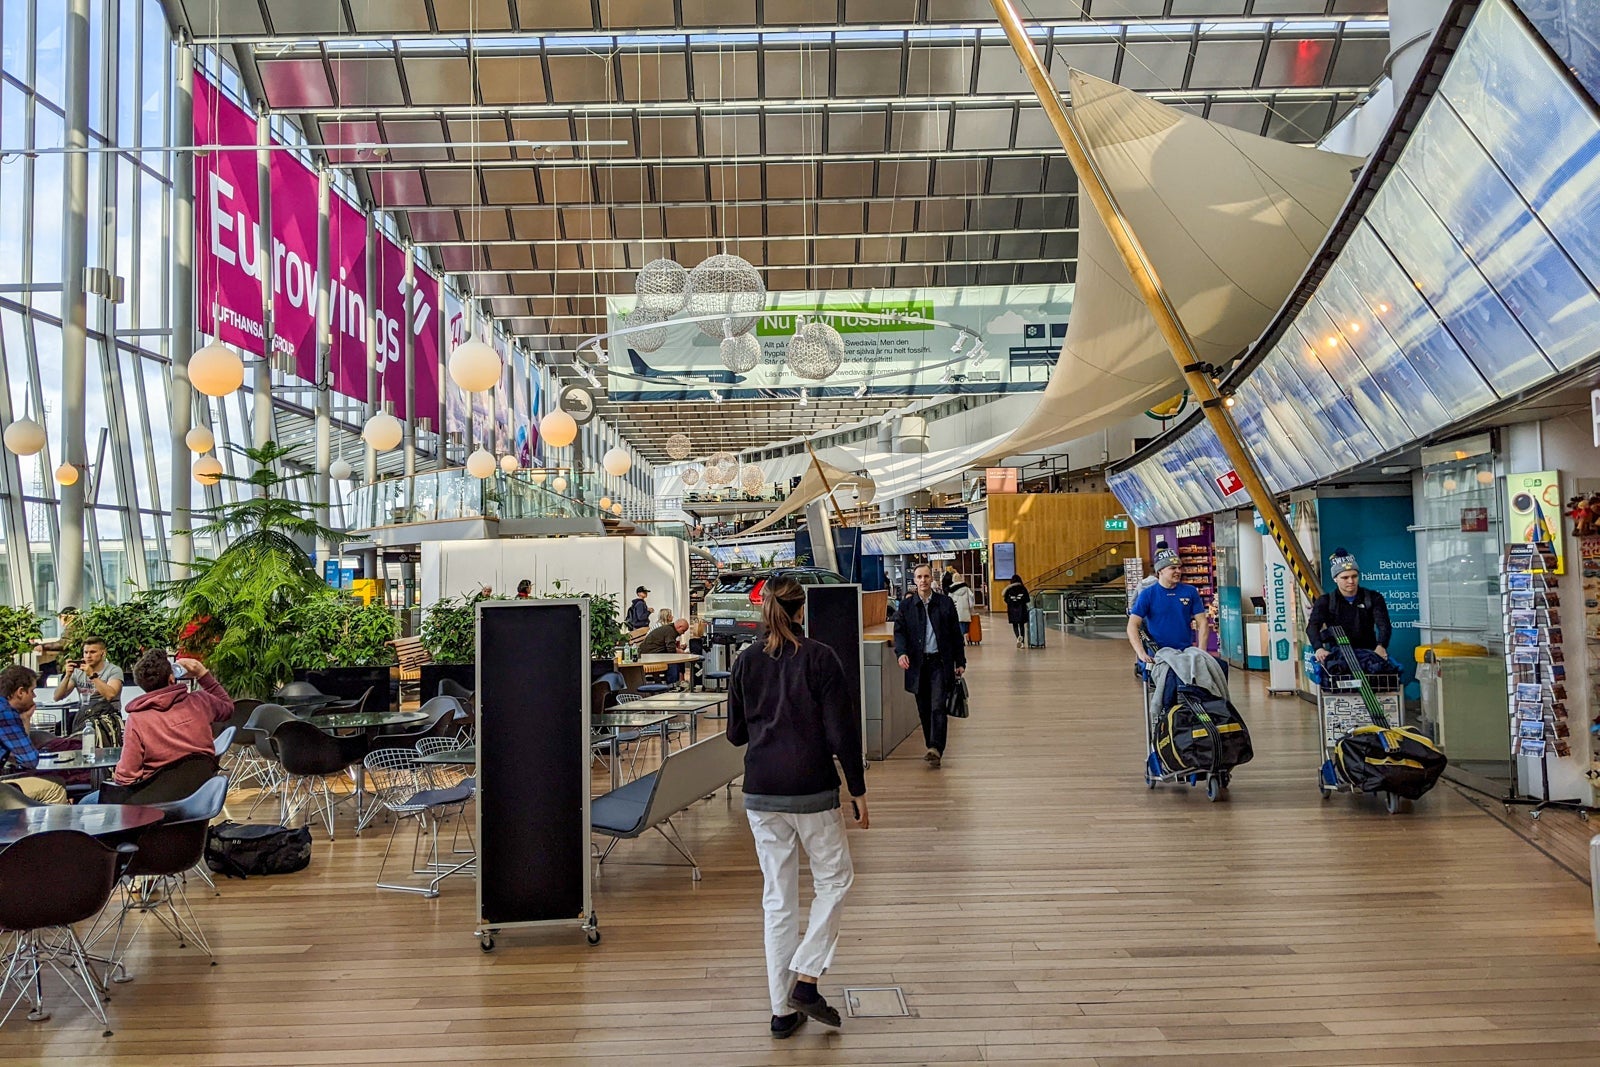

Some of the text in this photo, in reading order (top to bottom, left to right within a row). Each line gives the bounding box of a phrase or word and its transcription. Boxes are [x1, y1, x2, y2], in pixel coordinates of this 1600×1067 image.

[209, 170, 400, 373] Eurowings
[763, 312, 790, 330] Nu
[212, 302, 295, 356] LUFTHANSA GROUP
[764, 341, 775, 349] Allt
[775, 341, 785, 349] på
[764, 350, 786, 359] flygpla
[856, 347, 875, 356] själva
[894, 346, 906, 354] helt
[1379, 560, 1417, 569] Behöver
[1361, 572, 1416, 581] hämta ut ett
[1272, 562, 1287, 633] Pharmacy
[1389, 590, 1411, 600] köpa
